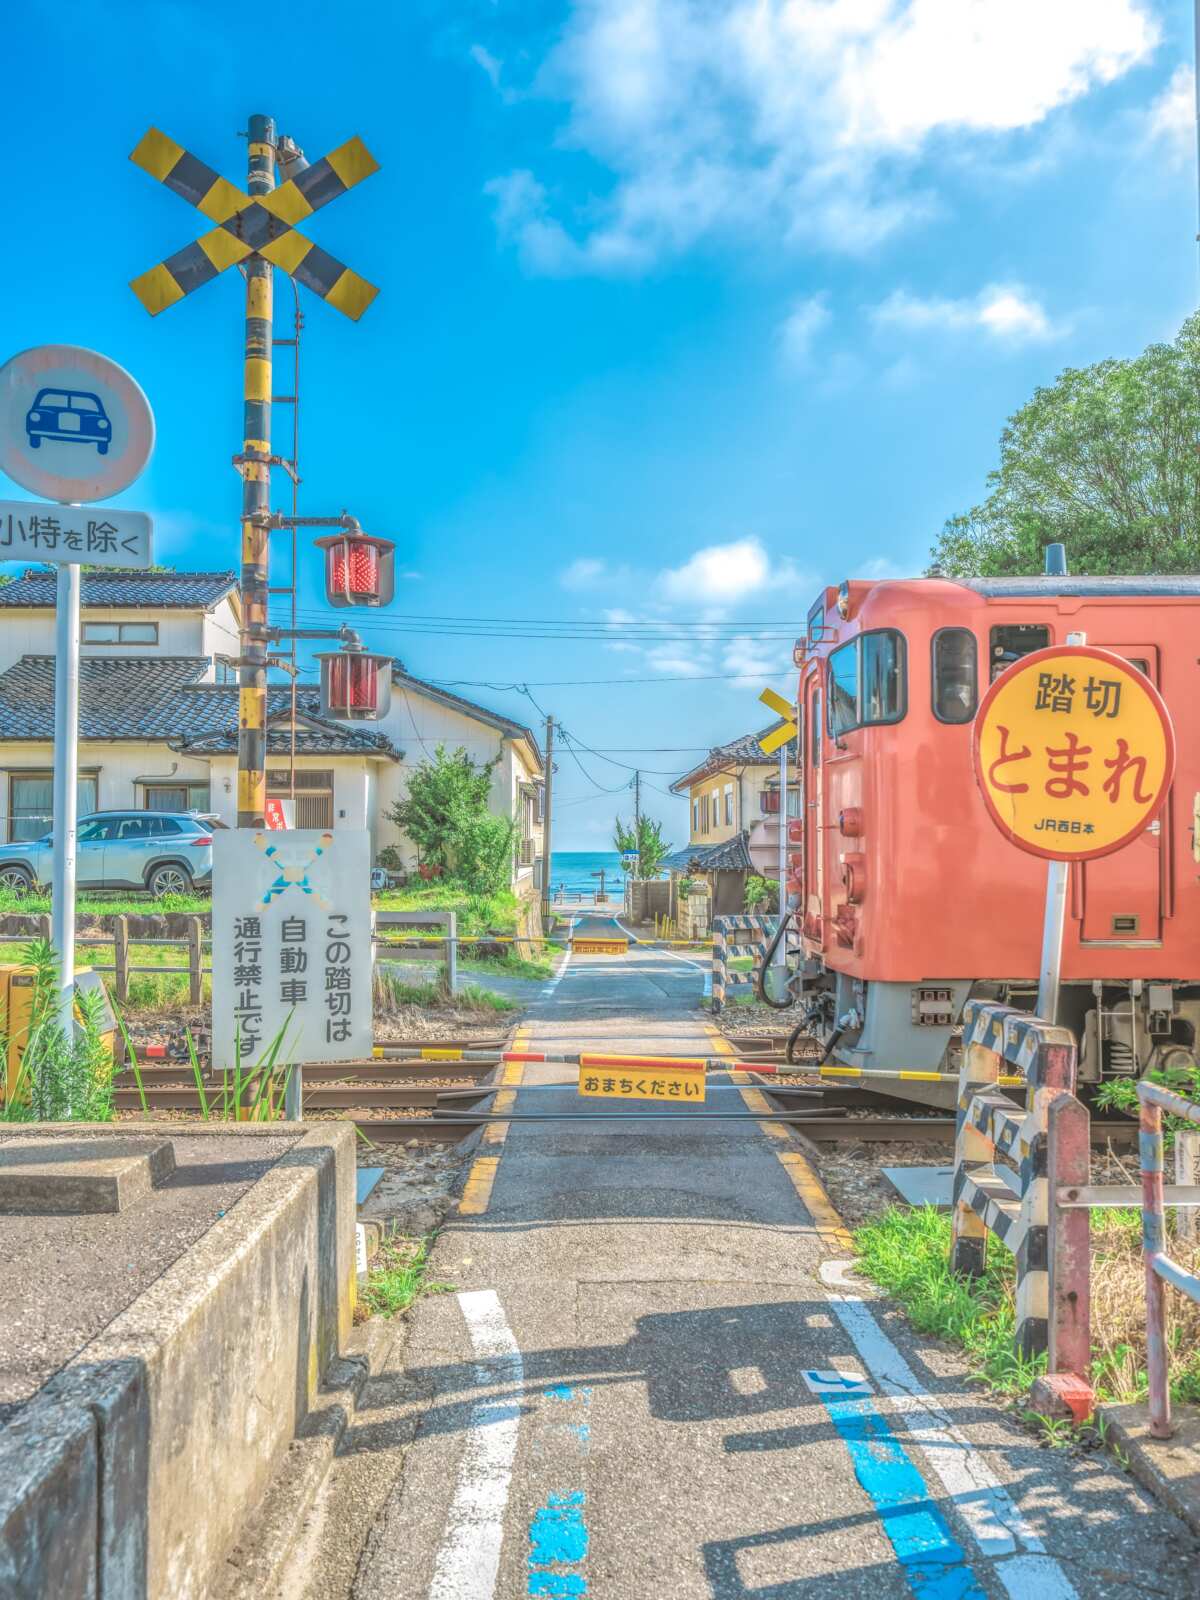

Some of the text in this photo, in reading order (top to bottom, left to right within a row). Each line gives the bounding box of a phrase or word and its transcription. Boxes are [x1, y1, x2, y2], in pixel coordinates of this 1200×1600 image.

[0, 514, 139, 555] 小特を除く
[1035, 673, 1121, 718] 踏切
[989, 725, 1153, 803] とまれ
[1034, 819, 1095, 834] JR西日本
[233, 917, 262, 1058] 通行禁止です
[280, 915, 307, 1006] 自動車
[325, 914, 352, 1043] この踏切は
[584, 1077, 700, 1096] おまちください
